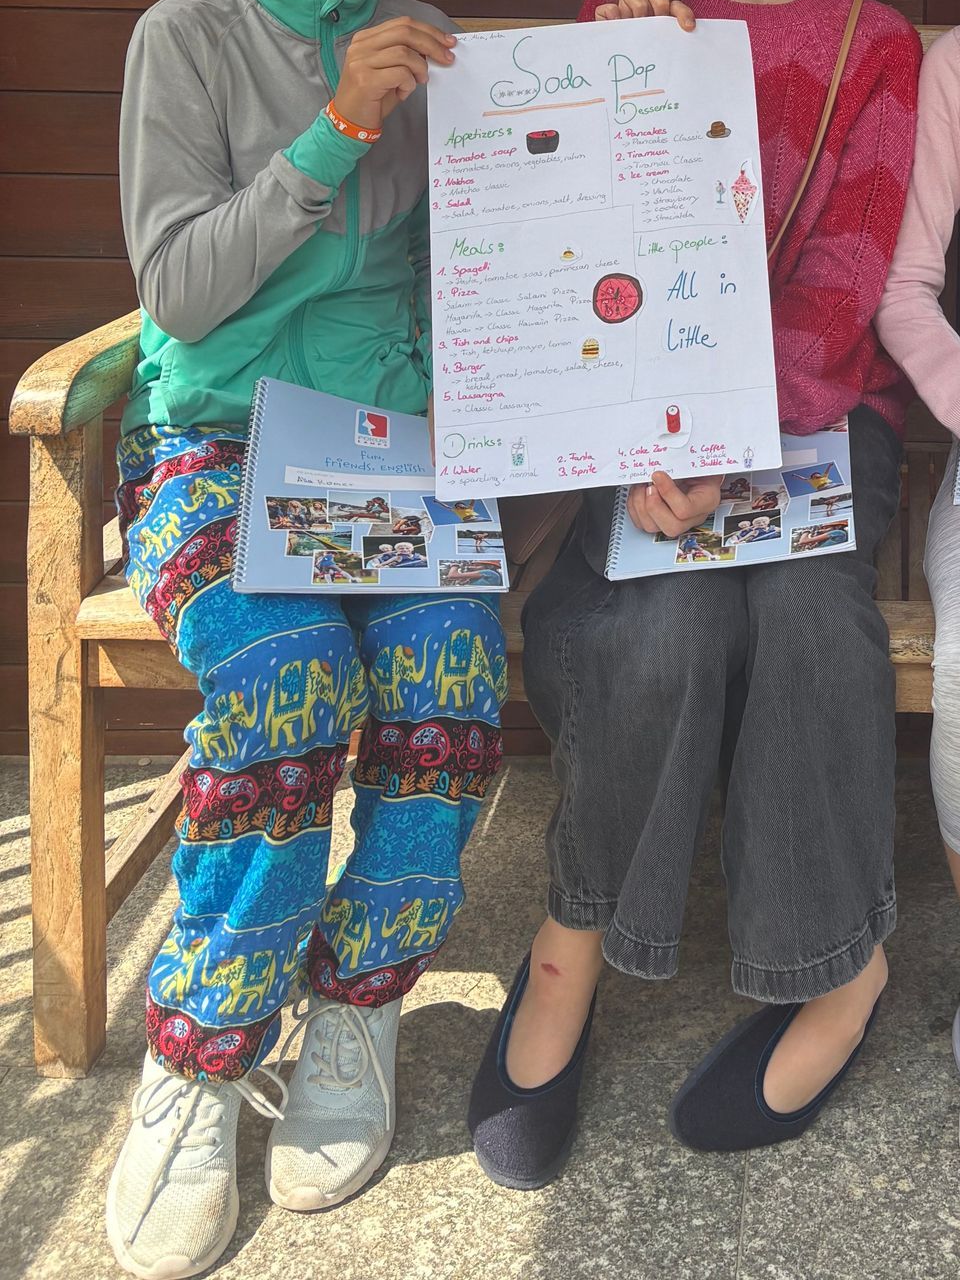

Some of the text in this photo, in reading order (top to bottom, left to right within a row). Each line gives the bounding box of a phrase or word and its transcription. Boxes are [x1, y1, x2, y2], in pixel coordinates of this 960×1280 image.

[490, 35, 656, 114] Soda Pop
[625, 127, 668, 138] Pancakes
[446, 152, 487, 164] Tomatoe
[491, 147, 517, 157] soup
[433, 179, 442, 188] 2.
[432, 198, 472, 210] 3. Salad
[449, 237, 504, 259] Meals:
[637, 235, 666, 257] Little
[595, 258, 620, 268] cheese
[436, 267, 447, 277] 1.
[552, 287, 578, 295] Pizza
[667, 270, 737, 301] All in
[437, 286, 480, 301] 2. Pizza
[569, 295, 592, 305] Pizza
[553, 313, 580, 323] Pizza
[451, 337, 470, 347] Fish
[473, 336, 491, 345] and
[442, 361, 486, 375] 4. Burger
[443, 391, 454, 401] 5.
[618, 444, 668, 457] 4. Coke Zero
[689, 443, 726, 454] 6. Coffee
[569, 452, 596, 461] Fanta
[726, 456, 739, 465] tea
[619, 461, 629, 470] 5.
[648, 457, 662, 467] tea
[440, 465, 481, 476] 1. Water
[509, 469, 539, 479] normal
[558, 463, 598, 477] 3. Sprite
